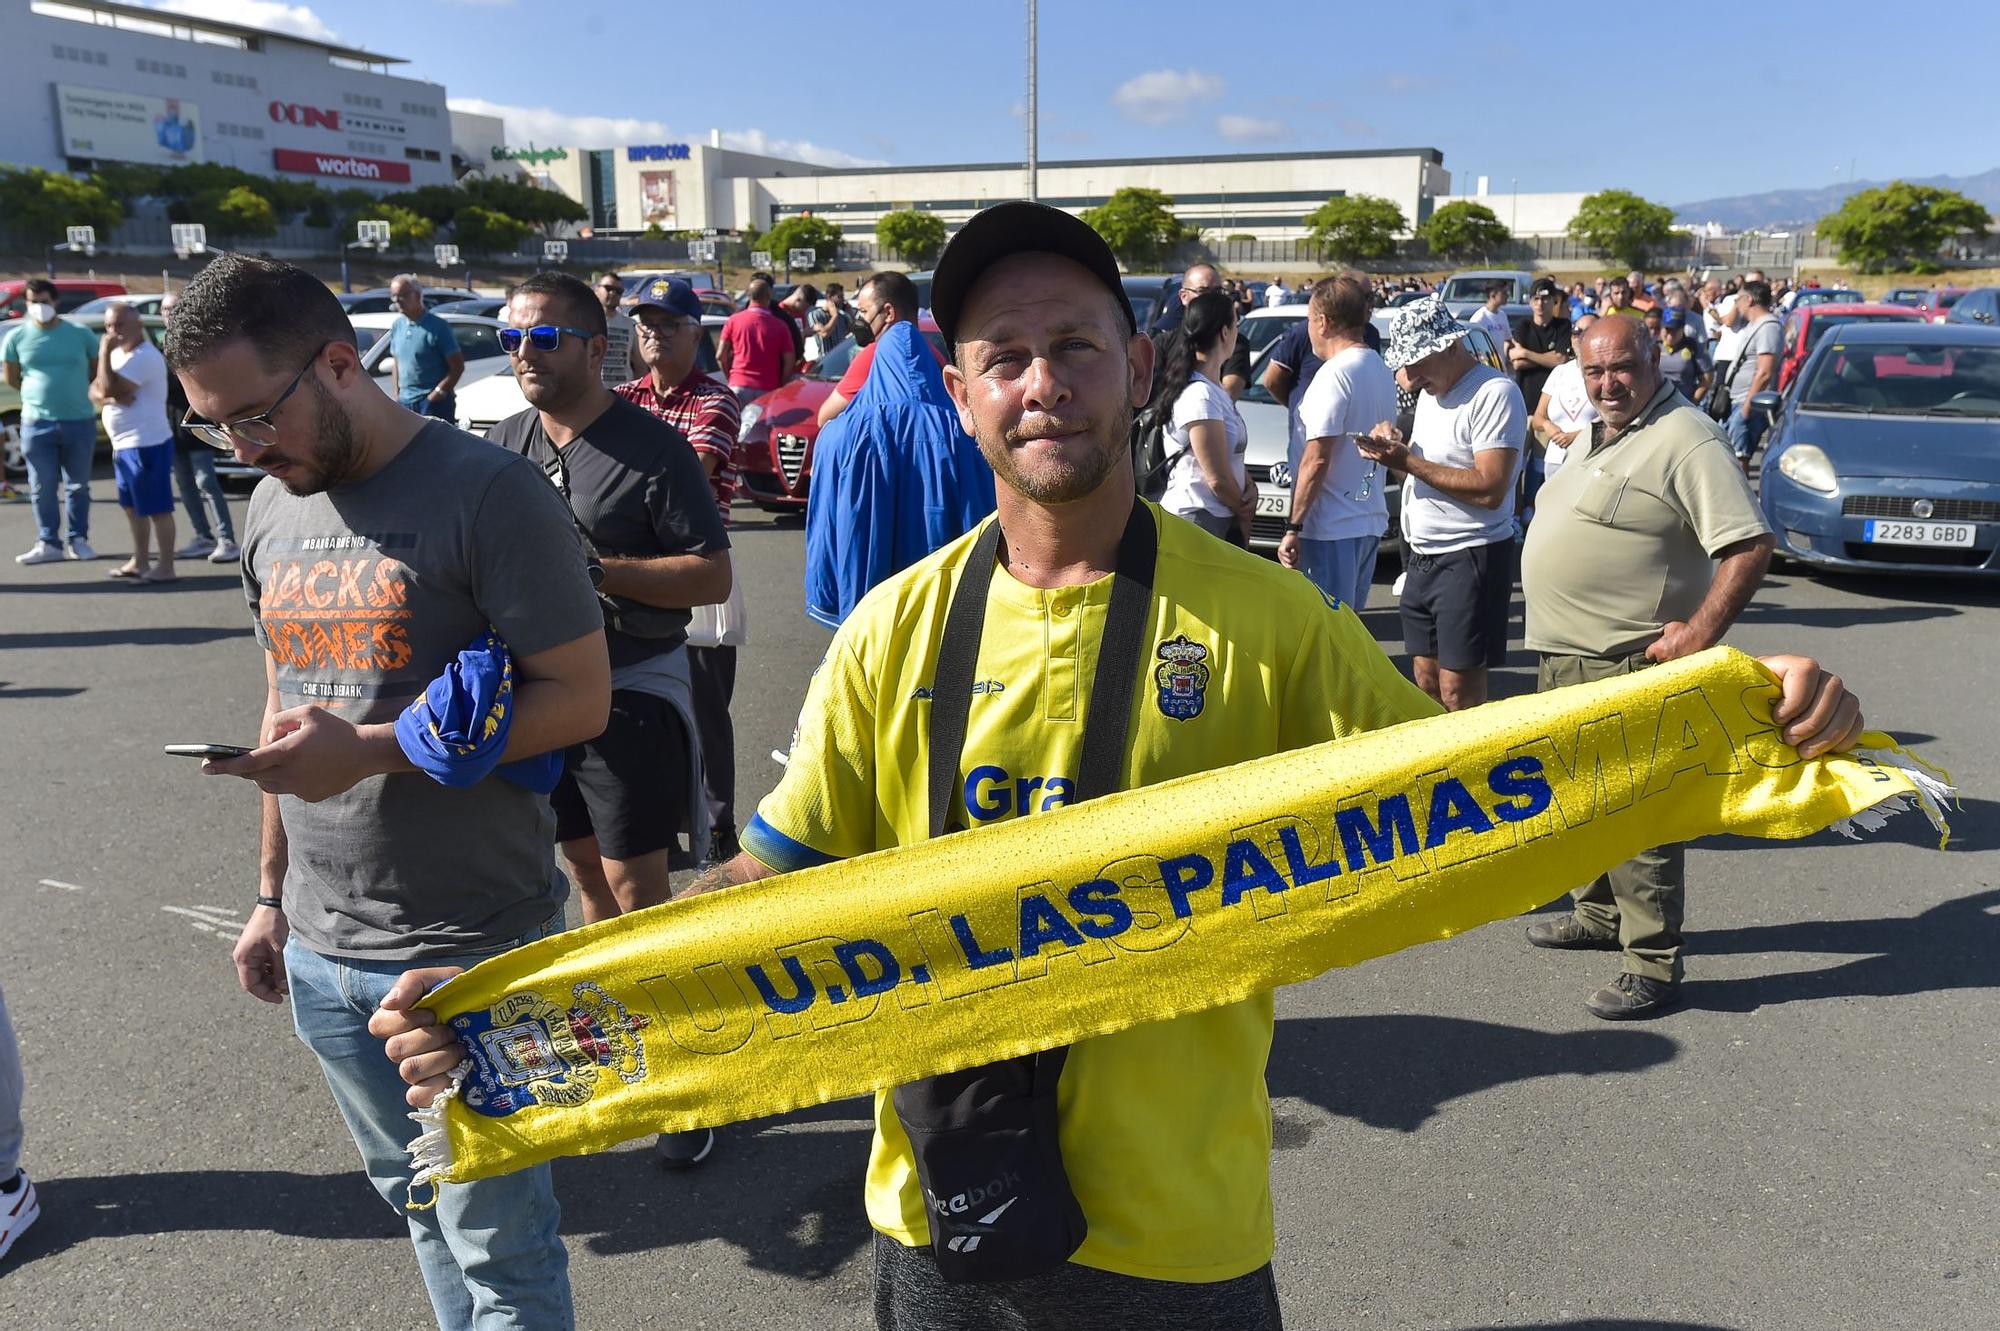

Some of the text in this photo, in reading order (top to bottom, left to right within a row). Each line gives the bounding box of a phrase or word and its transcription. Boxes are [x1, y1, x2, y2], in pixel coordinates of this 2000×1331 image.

[316, 157, 381, 178] worten
[1879, 524, 1968, 543] 2283 GBD
[267, 620, 413, 672] JONES
[747, 755, 1553, 1014] U.D. LAS PALMAS
